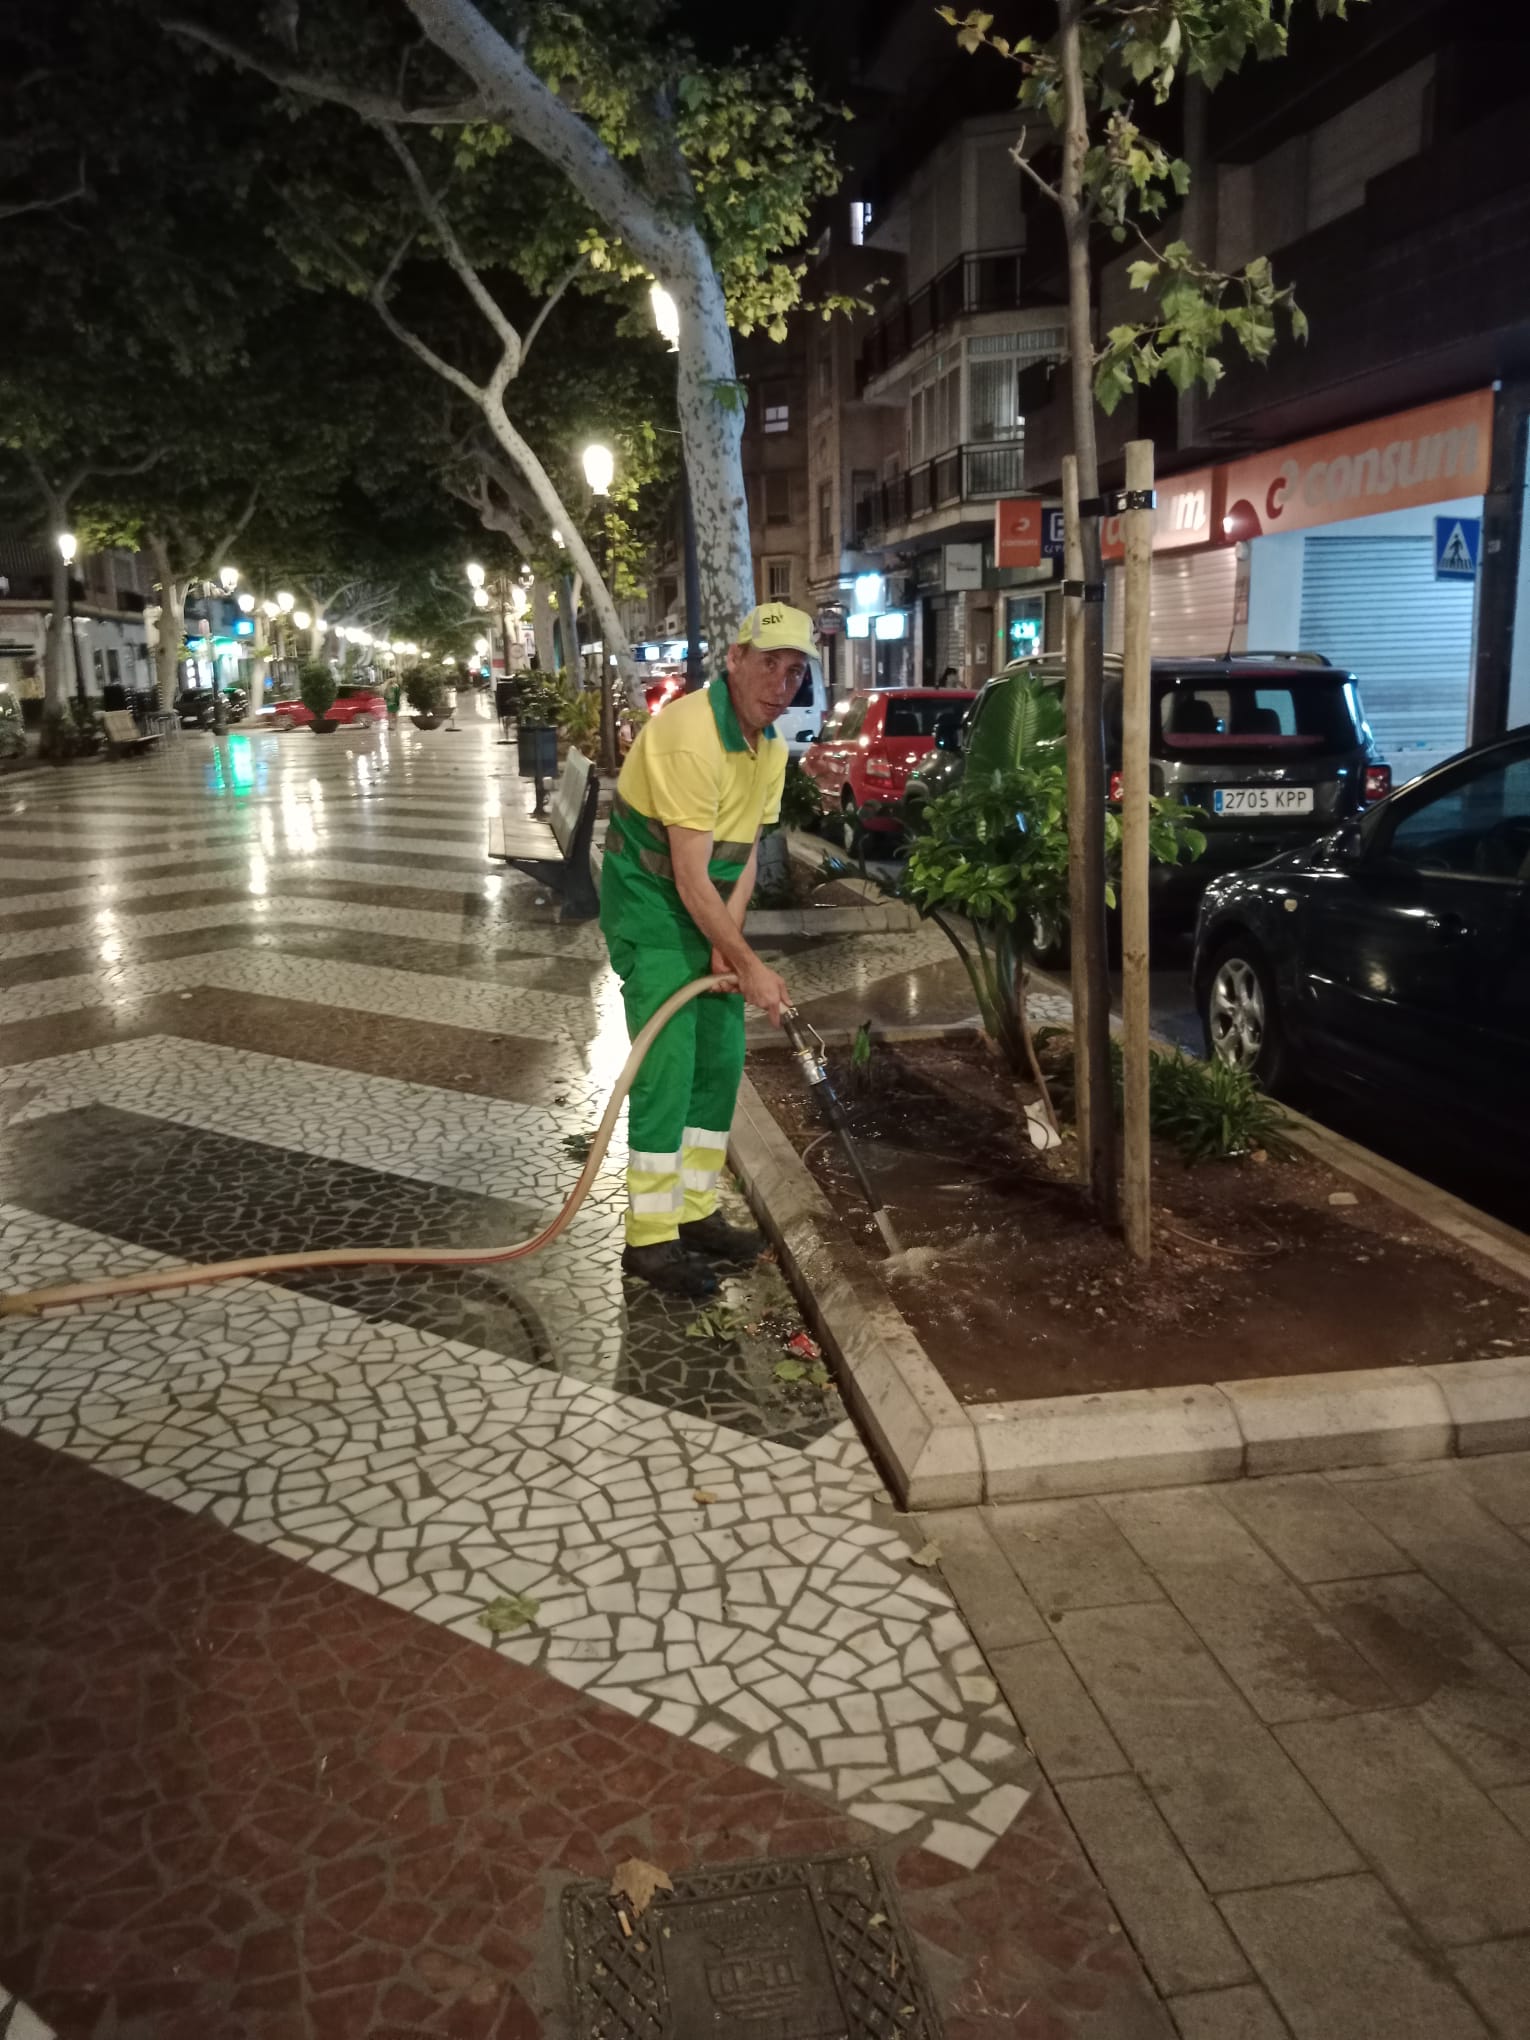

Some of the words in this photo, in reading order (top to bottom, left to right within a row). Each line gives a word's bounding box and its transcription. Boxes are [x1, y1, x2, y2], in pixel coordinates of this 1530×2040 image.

[1304, 421, 1478, 507] consum
[1225, 792, 1269, 809] 2705
[1275, 791, 1307, 808] KPP
